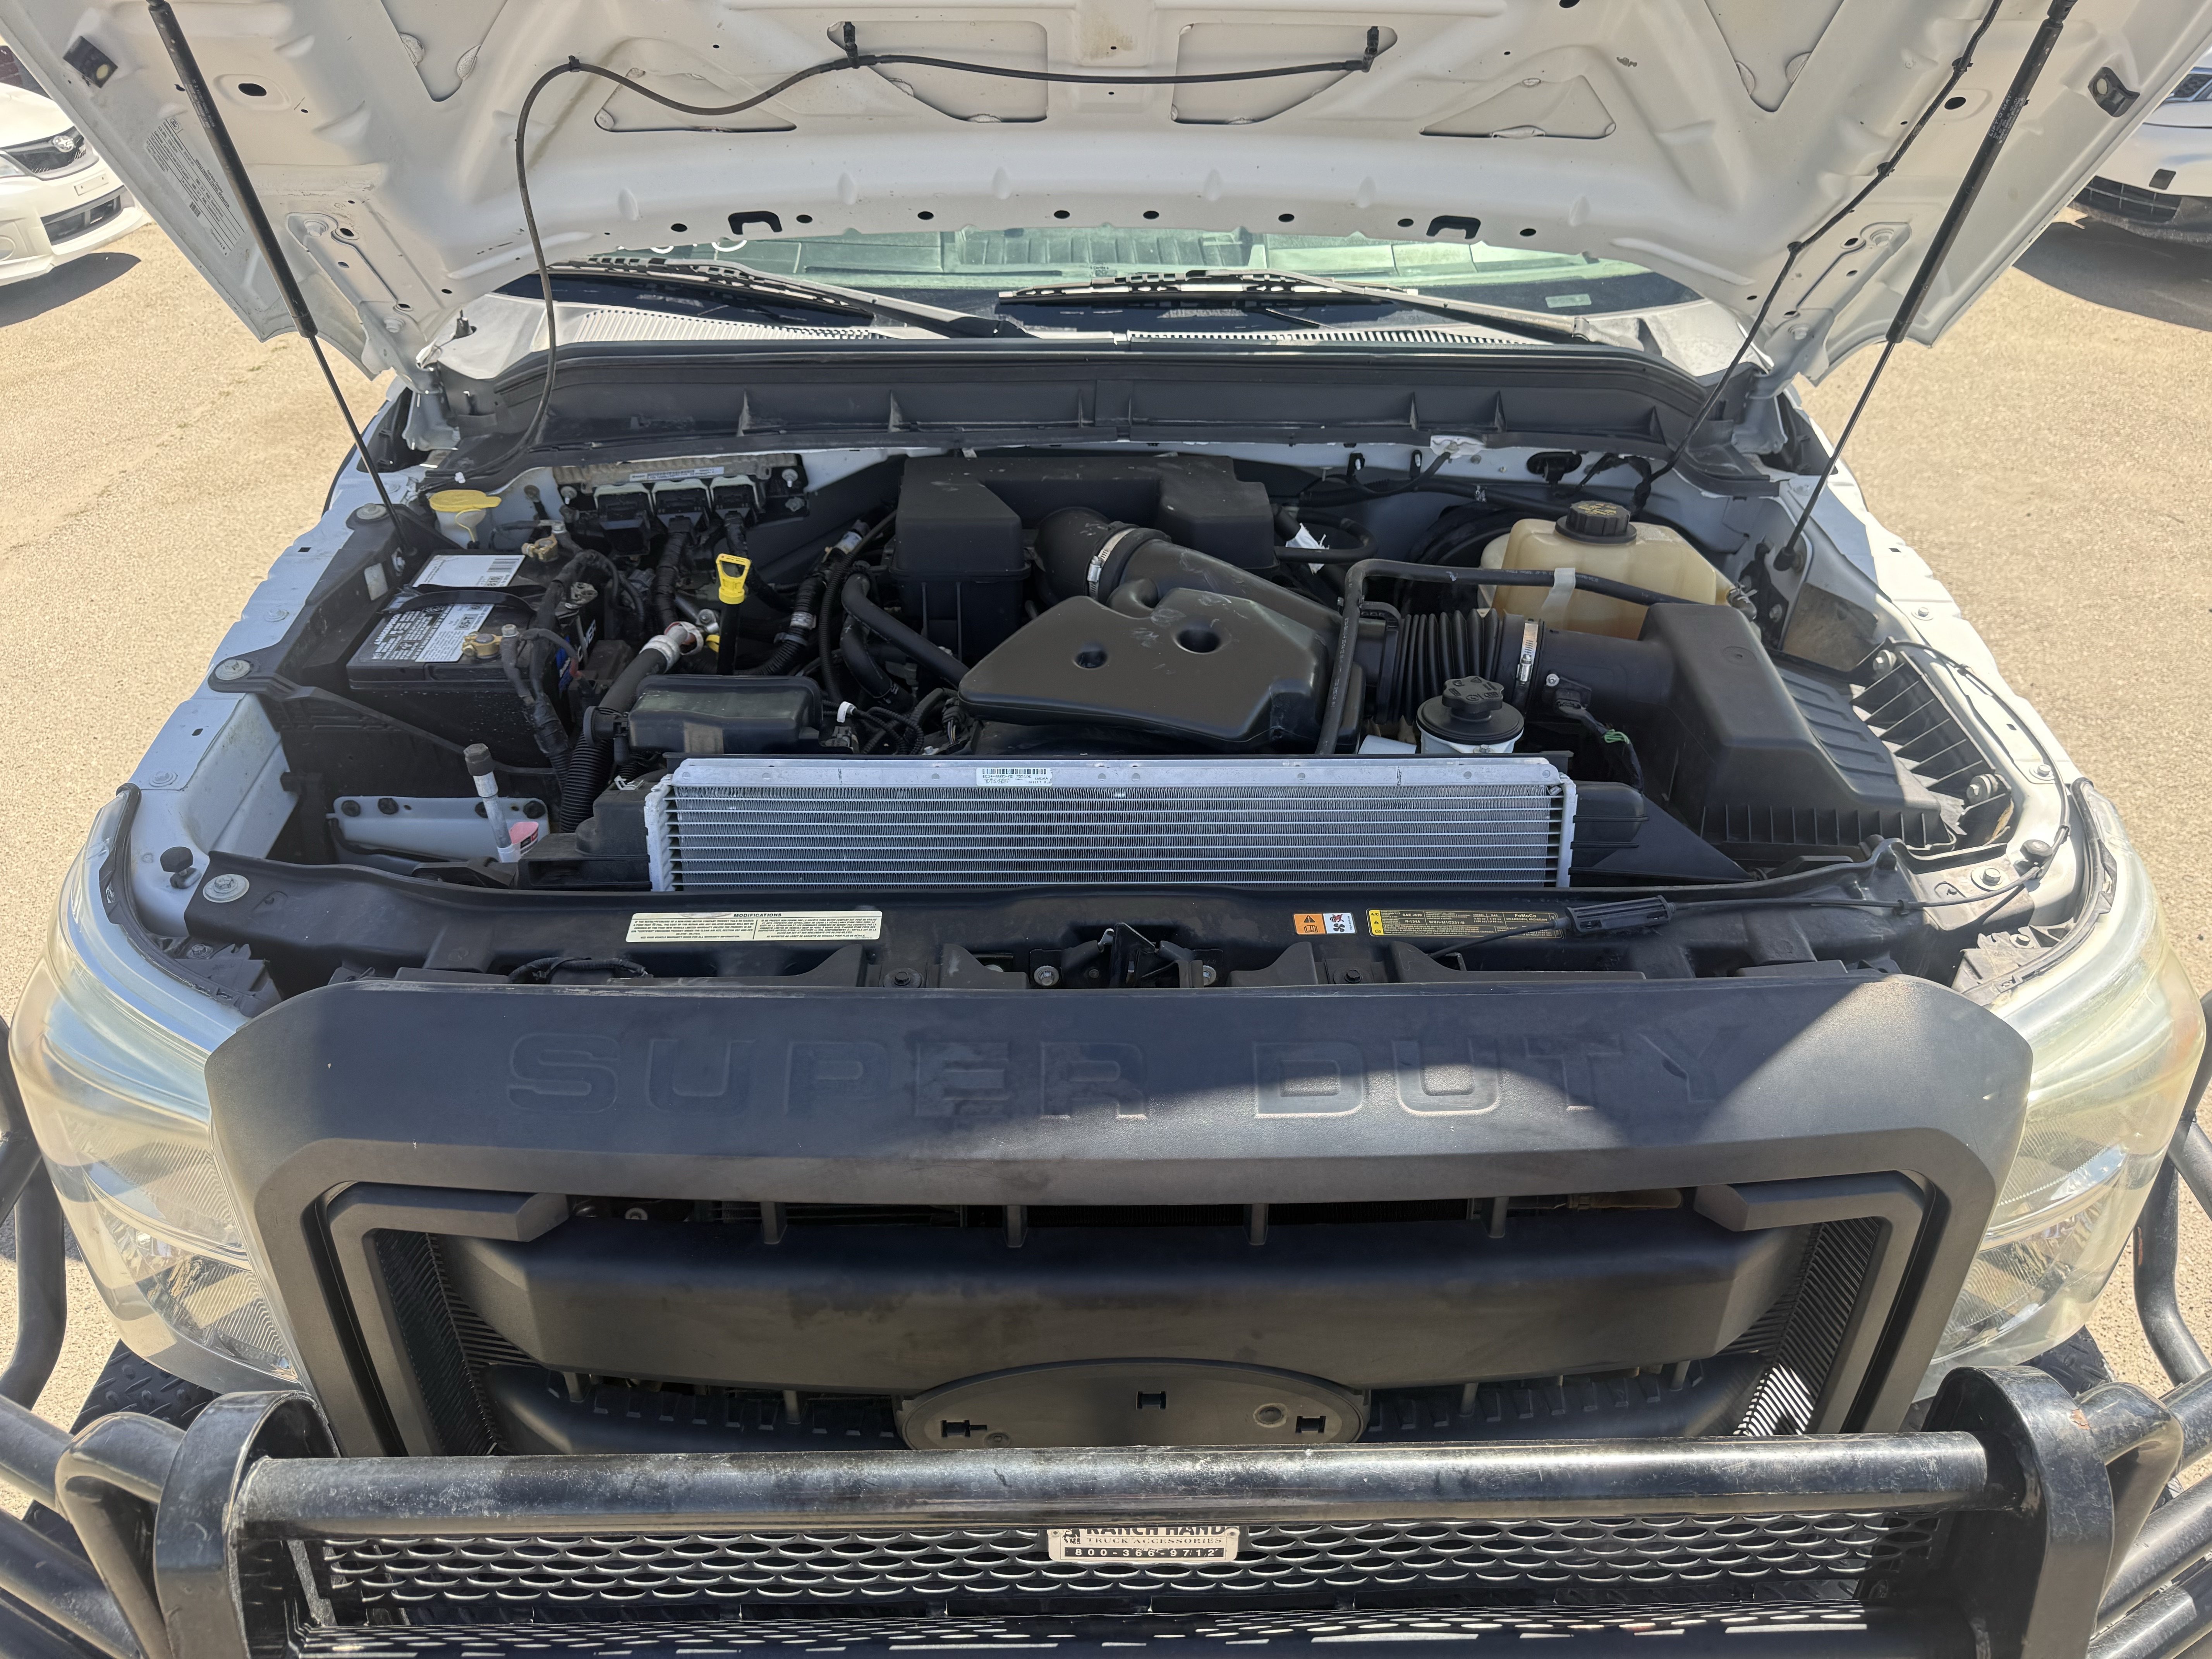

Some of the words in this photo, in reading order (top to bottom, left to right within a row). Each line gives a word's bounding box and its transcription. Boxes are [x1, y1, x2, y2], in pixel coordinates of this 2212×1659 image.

[459, 616, 474, 628] 65-T
[506, 1032, 1149, 1120] SUPER
[1252, 1025, 1748, 1118] DUTY
[1087, 1527, 1158, 1535] RANCH
[1166, 1526, 1225, 1535] HAND
